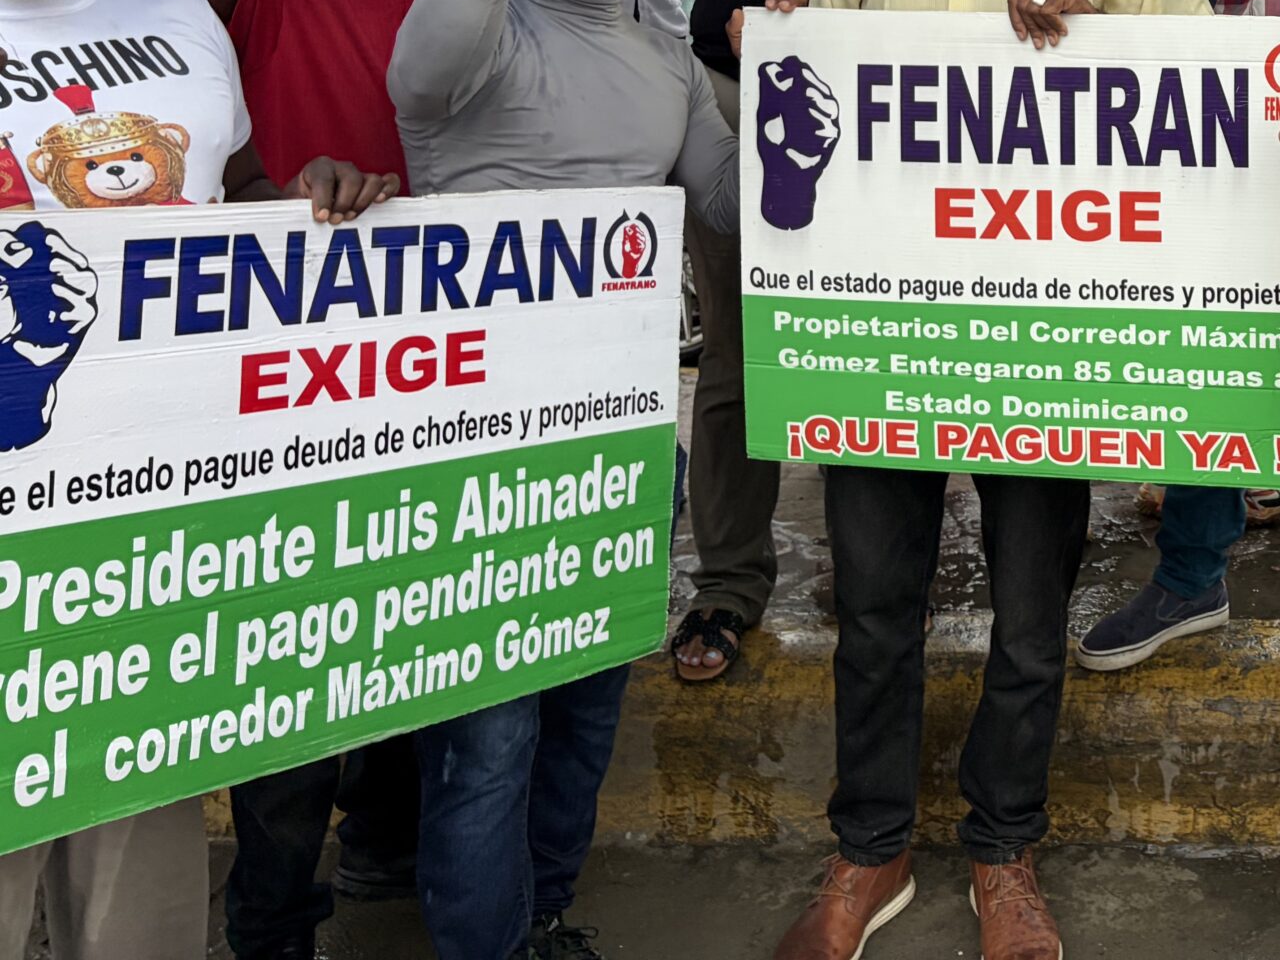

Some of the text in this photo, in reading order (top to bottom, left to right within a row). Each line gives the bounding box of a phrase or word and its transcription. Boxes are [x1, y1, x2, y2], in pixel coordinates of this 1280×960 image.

[857, 64, 1250, 168] FENATRAN
[934, 188, 1162, 243] EXIGE
[117, 217, 597, 342] FENATRAN
[601, 279, 657, 292] FENATRANO
[749, 266, 790, 292] Que
[796, 269, 814, 292] el
[820, 269, 892, 295] estado
[898, 278, 965, 302] pague
[971, 275, 1038, 300] deuda
[1045, 276, 1071, 300] de
[1077, 278, 1175, 303] choferes
[1182, 286, 1194, 308] y
[774, 311, 958, 344] Propietarios
[969, 319, 1018, 342] Del
[1029, 321, 1170, 347] Corredor
[238, 329, 487, 415] EXIGE
[778, 348, 879, 373] Gómez
[890, 354, 1063, 384] Entregaron
[1073, 360, 1112, 382] 85
[1122, 362, 1263, 390] Guaguas
[885, 389, 1189, 423] Estado Dominicano
[27, 470, 56, 511] el
[66, 456, 174, 506] estado
[183, 447, 274, 496] pague
[283, 428, 366, 470] deuda
[373, 421, 404, 455] de
[411, 405, 513, 448] choferes
[518, 410, 532, 442] y
[537, 386, 665, 437] propietarios.
[786, 415, 920, 459] ¡QUE
[933, 421, 1166, 471] PAGUEN
[1181, 431, 1260, 474] YA
[0, 453, 646, 634] Presidente Luis Abinader
[0, 526, 655, 724] dene el pago pendiente con
[13, 605, 610, 809] el corredor Máximo Gómez
